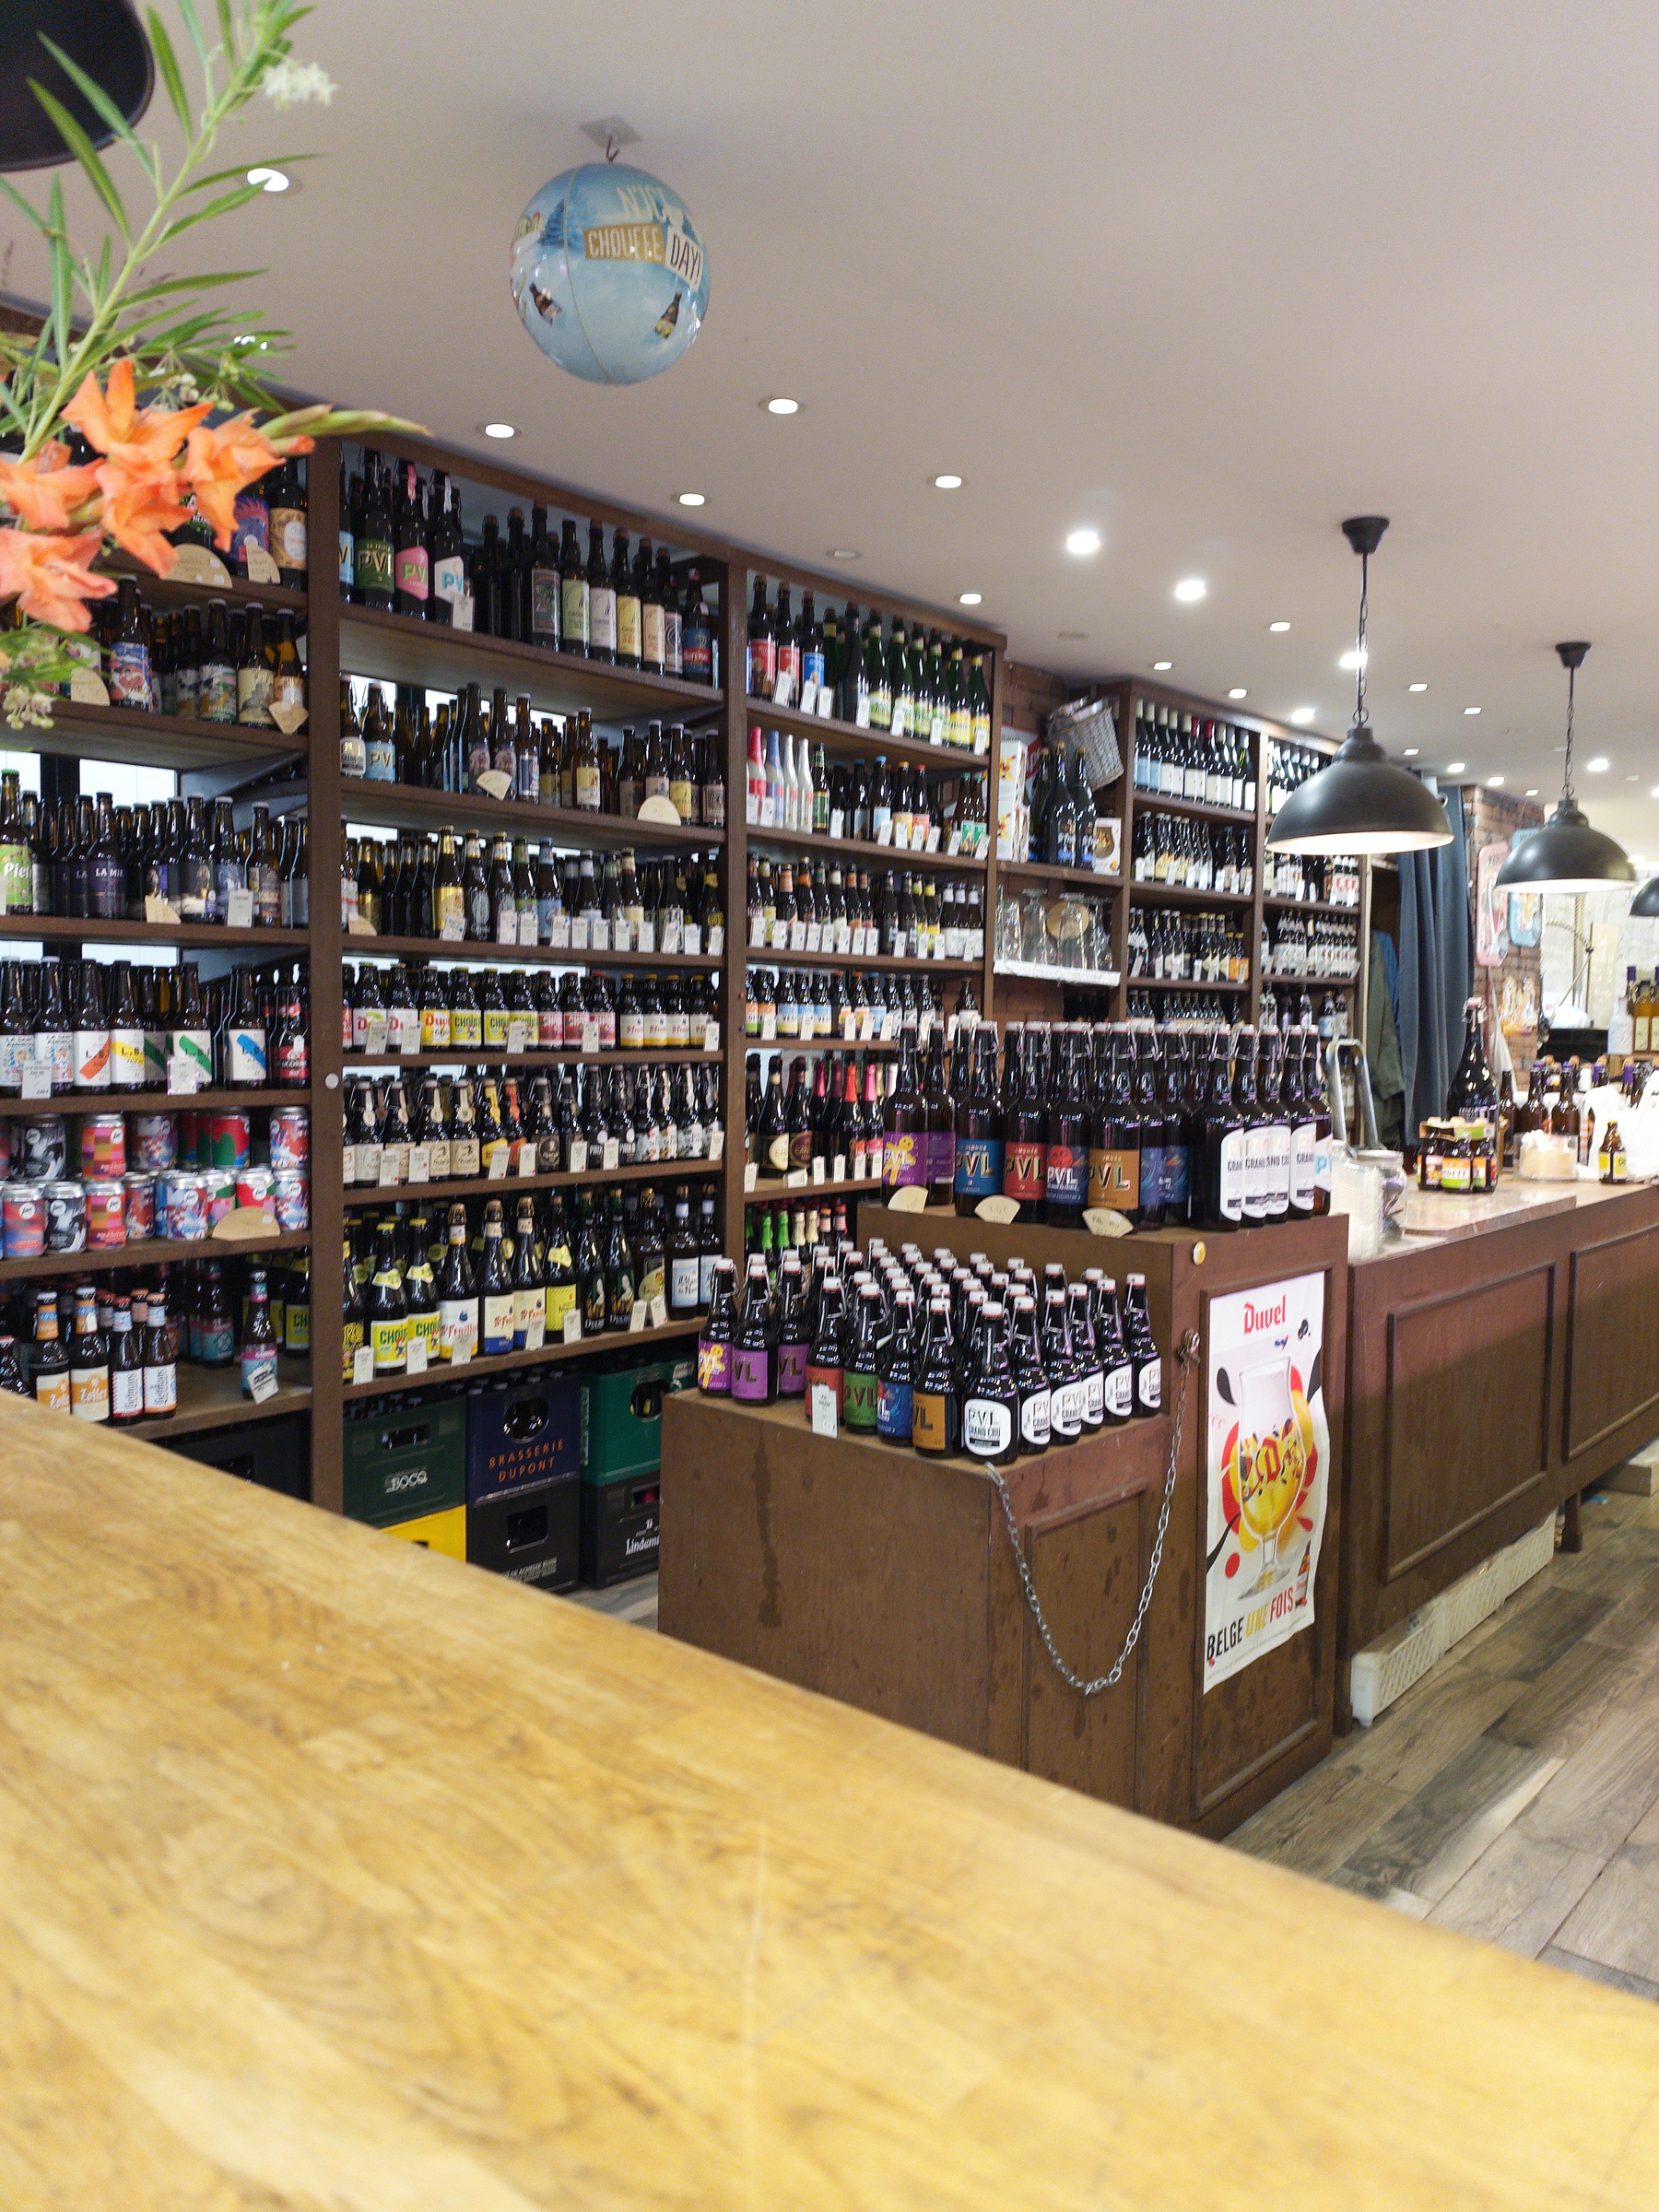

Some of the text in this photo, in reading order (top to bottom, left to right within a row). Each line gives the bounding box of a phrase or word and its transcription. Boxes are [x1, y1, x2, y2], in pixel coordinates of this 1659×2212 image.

[587, 227, 701, 286] CHOUFFE DAY!
[1047, 1167, 1077, 1187] PVL
[1242, 1293, 1287, 1336] Duvel
[488, 1438, 565, 1470] BRASSERIE
[498, 1456, 557, 1485] DUPONT
[1206, 1616, 1244, 1663] BELGE
[1245, 1602, 1269, 1639] UNE
[1269, 1586, 1294, 1624] FOIS
